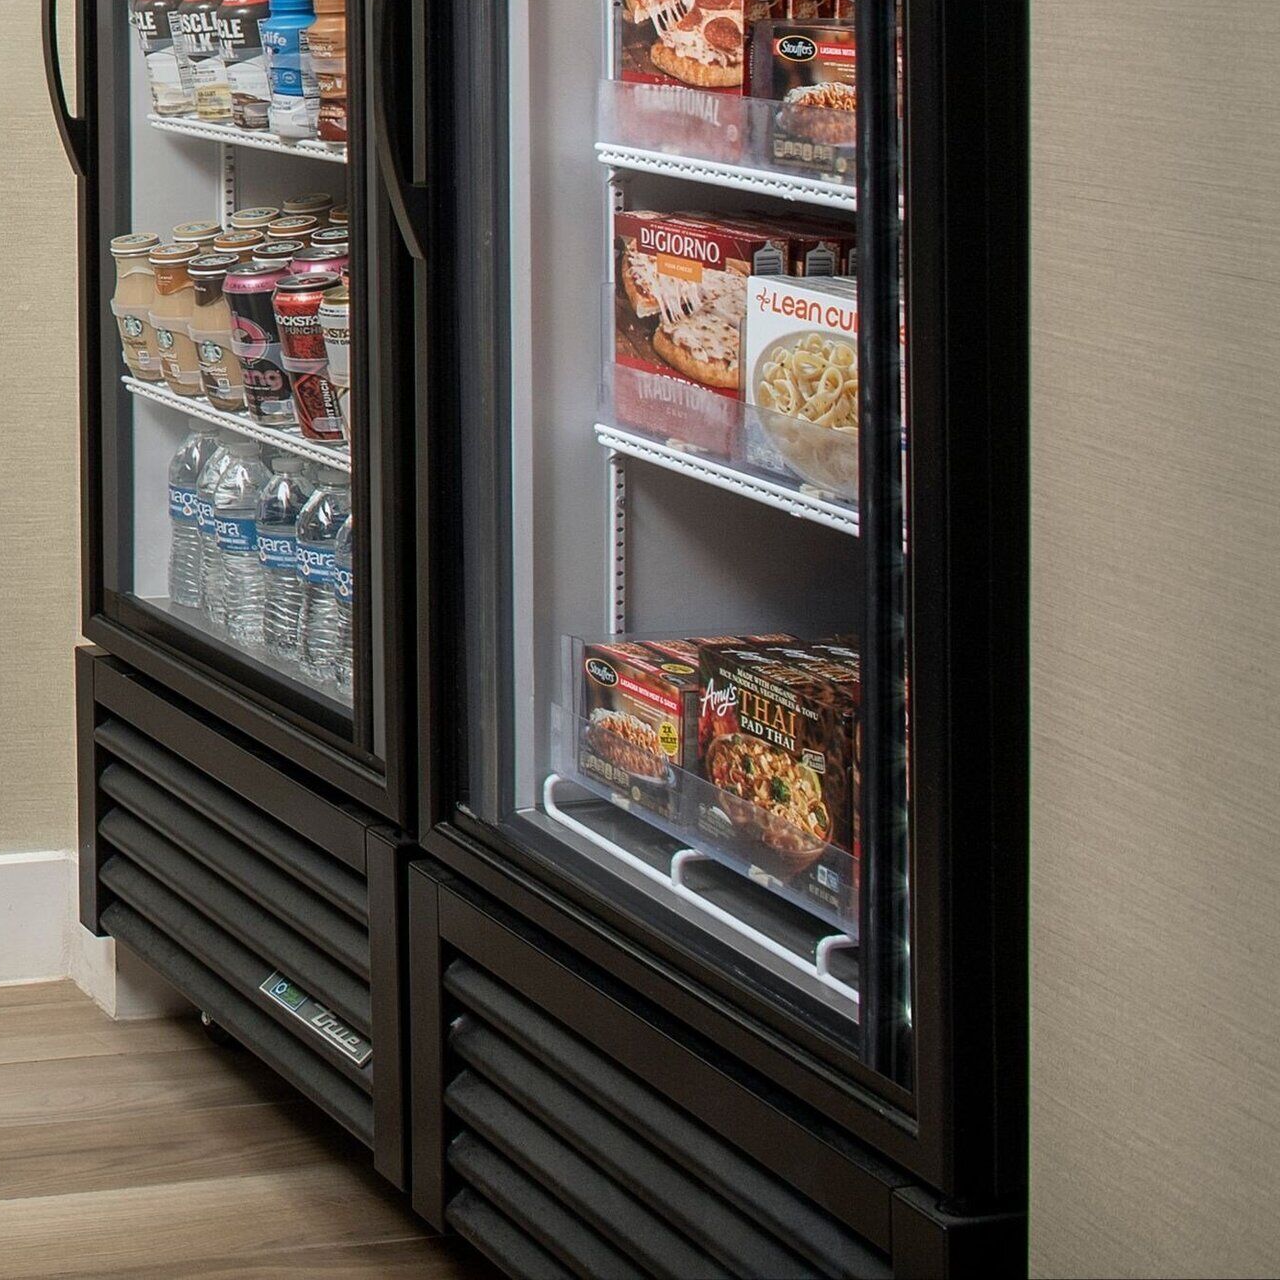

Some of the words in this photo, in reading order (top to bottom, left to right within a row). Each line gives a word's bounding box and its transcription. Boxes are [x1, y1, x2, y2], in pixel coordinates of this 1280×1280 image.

[781, 39, 813, 56] Stouffer's
[641, 228, 721, 263] DIGIORNO
[772, 293, 821, 325] Lean
[700, 677, 737, 718] Amy's
[754, 675, 770, 688] WITH
[739, 687, 796, 739] THAI
[741, 715, 764, 735] PAD
[765, 728, 795, 752] THAI
